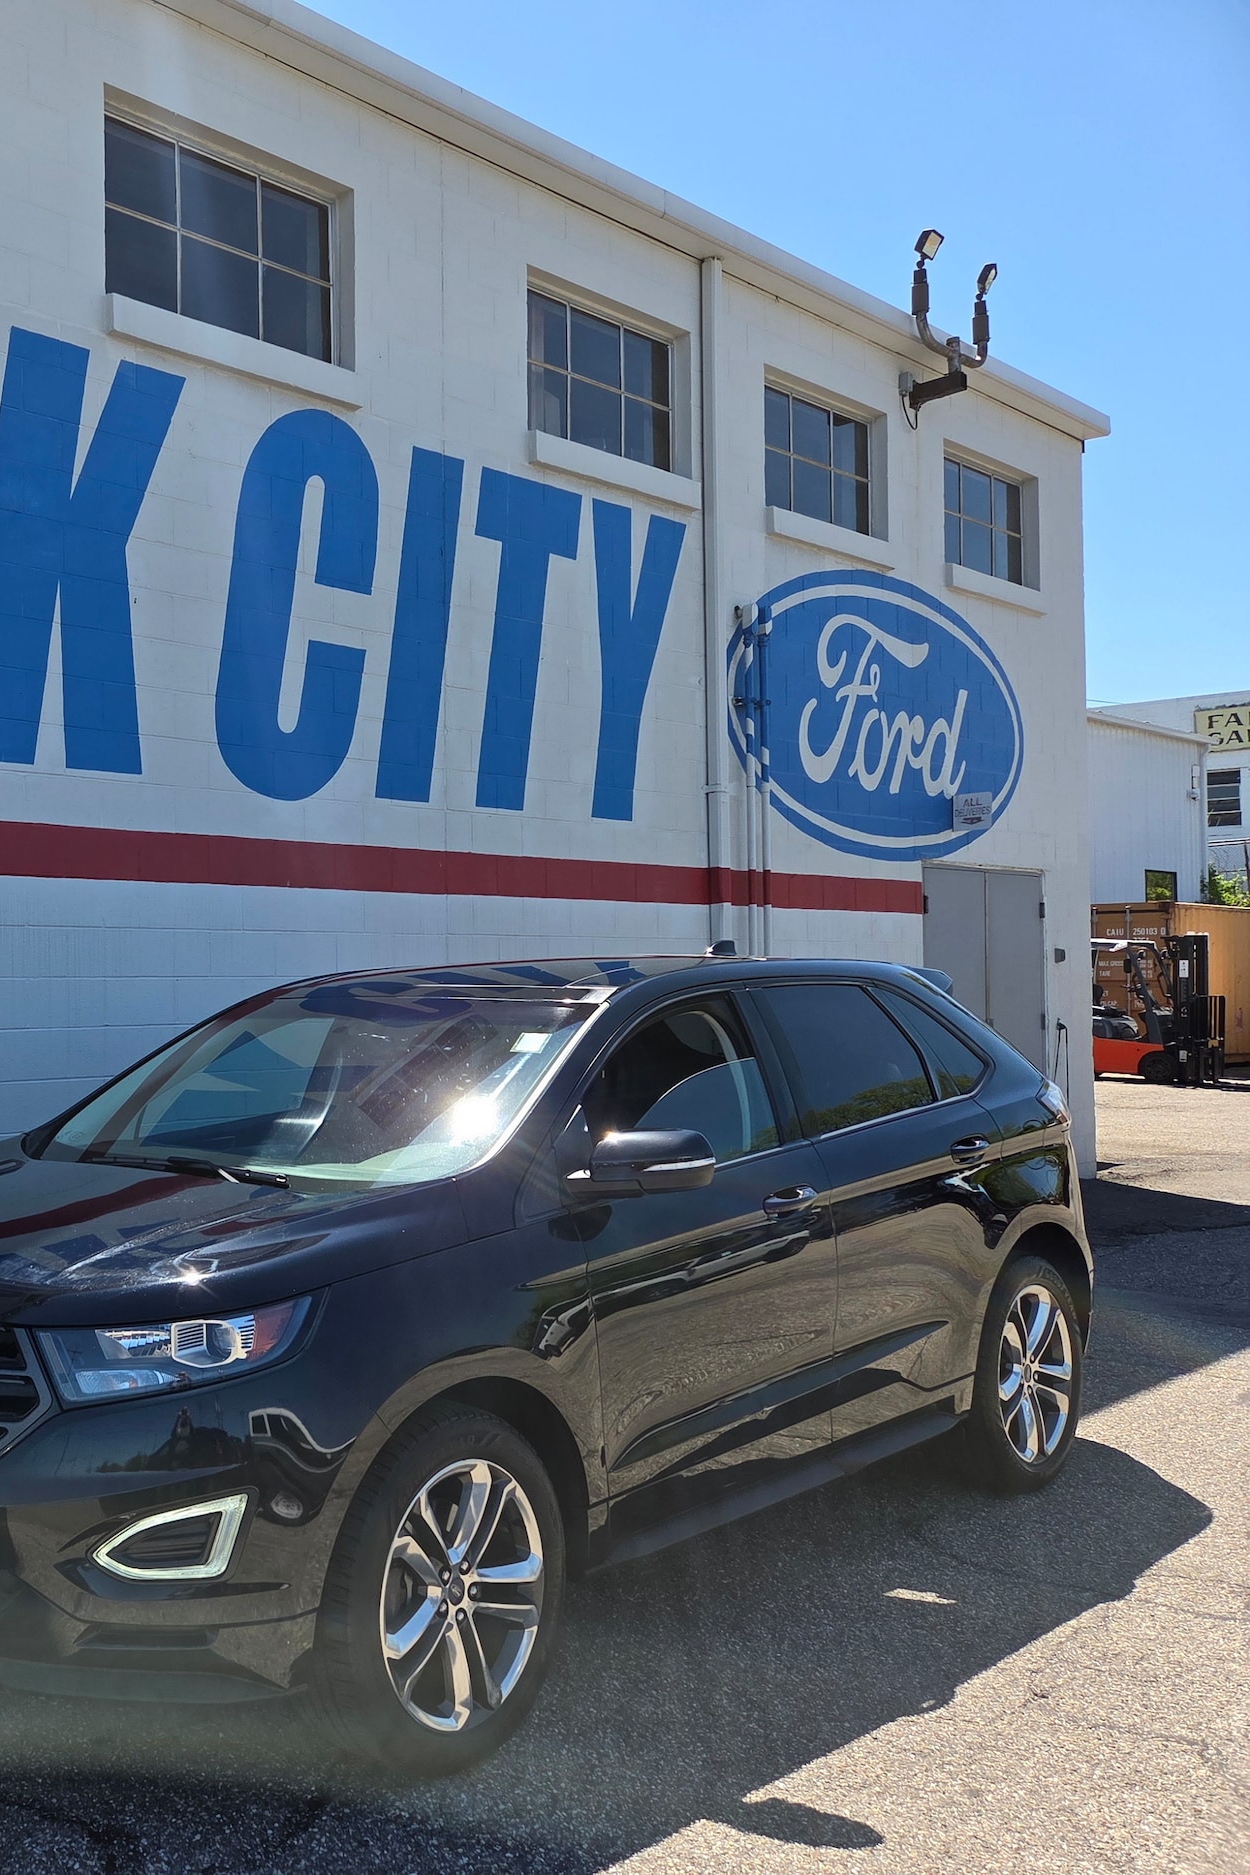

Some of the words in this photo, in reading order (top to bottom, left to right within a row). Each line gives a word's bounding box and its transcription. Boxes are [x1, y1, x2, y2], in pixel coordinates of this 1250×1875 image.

[214, 408, 687, 821] CITY
[799, 613, 969, 800] Ford
[1207, 711, 1250, 730] FA
[1207, 729, 1250, 747] GA
[962, 797, 983, 807] ALL
[954, 806, 992, 818] DELIVERIES
[1106, 928, 1124, 936] CAIU
[1132, 927, 1158, 936] 250103
